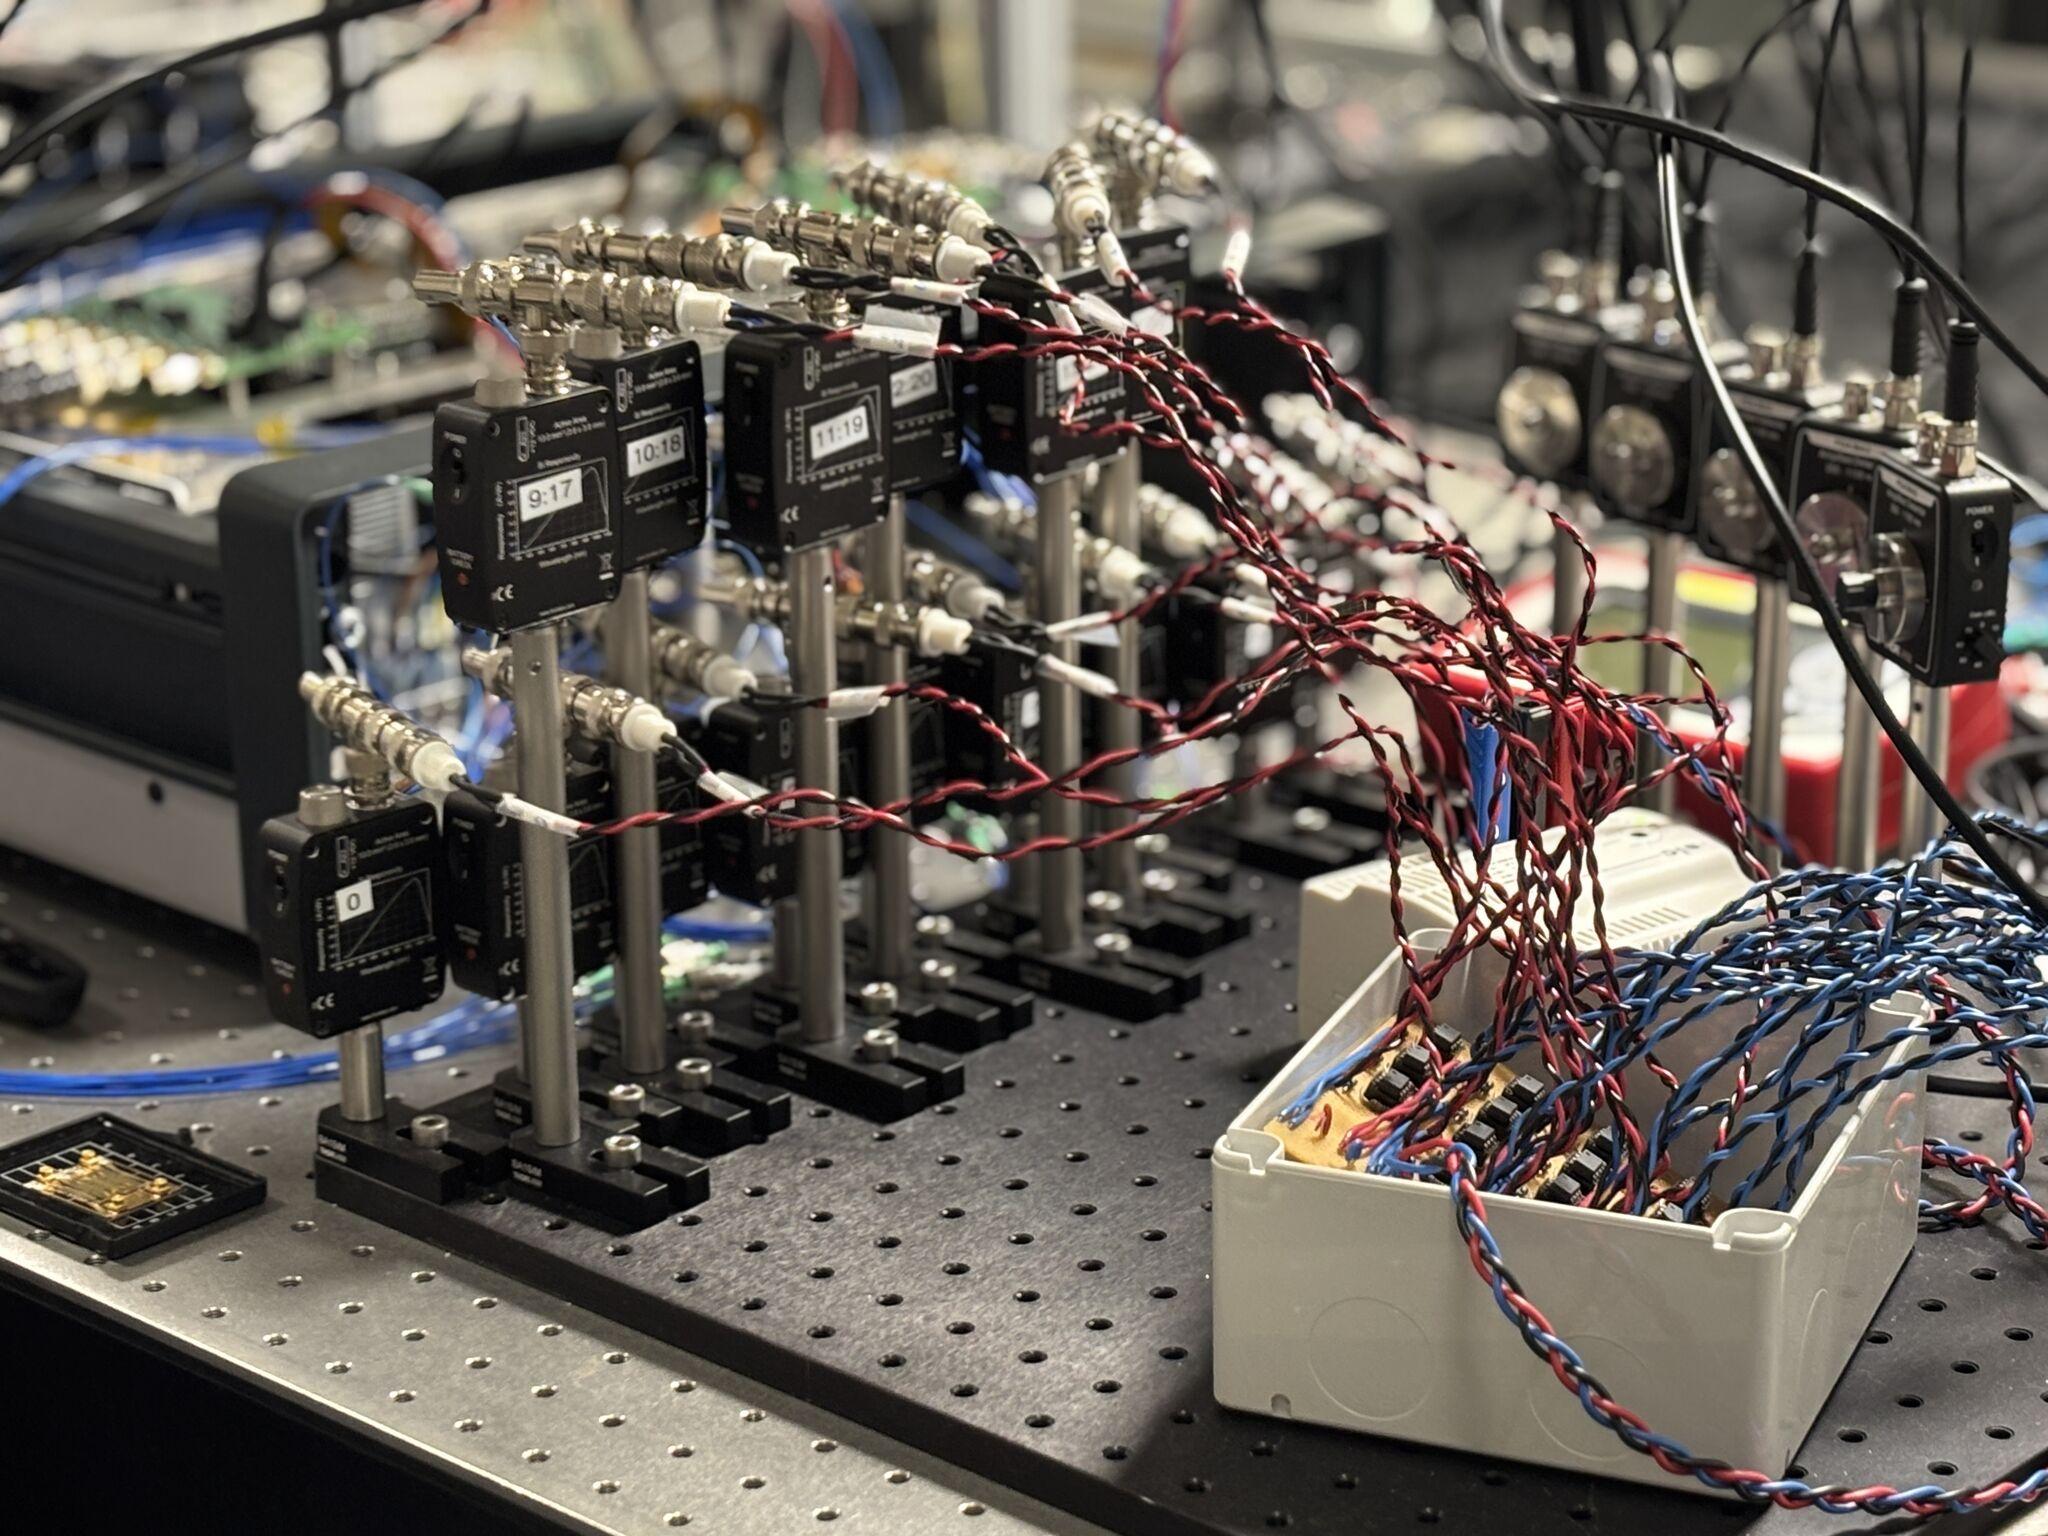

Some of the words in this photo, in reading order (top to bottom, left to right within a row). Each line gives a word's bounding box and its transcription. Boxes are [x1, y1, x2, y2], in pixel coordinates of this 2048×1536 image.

[893, 369, 932, 397] 2:20
[815, 414, 864, 448] 11:19
[634, 433, 682, 465] 10:18
[528, 478, 574, 509] 9:17
[1965, 504, 1994, 516] POWER
[346, 892, 361, 911] 0
